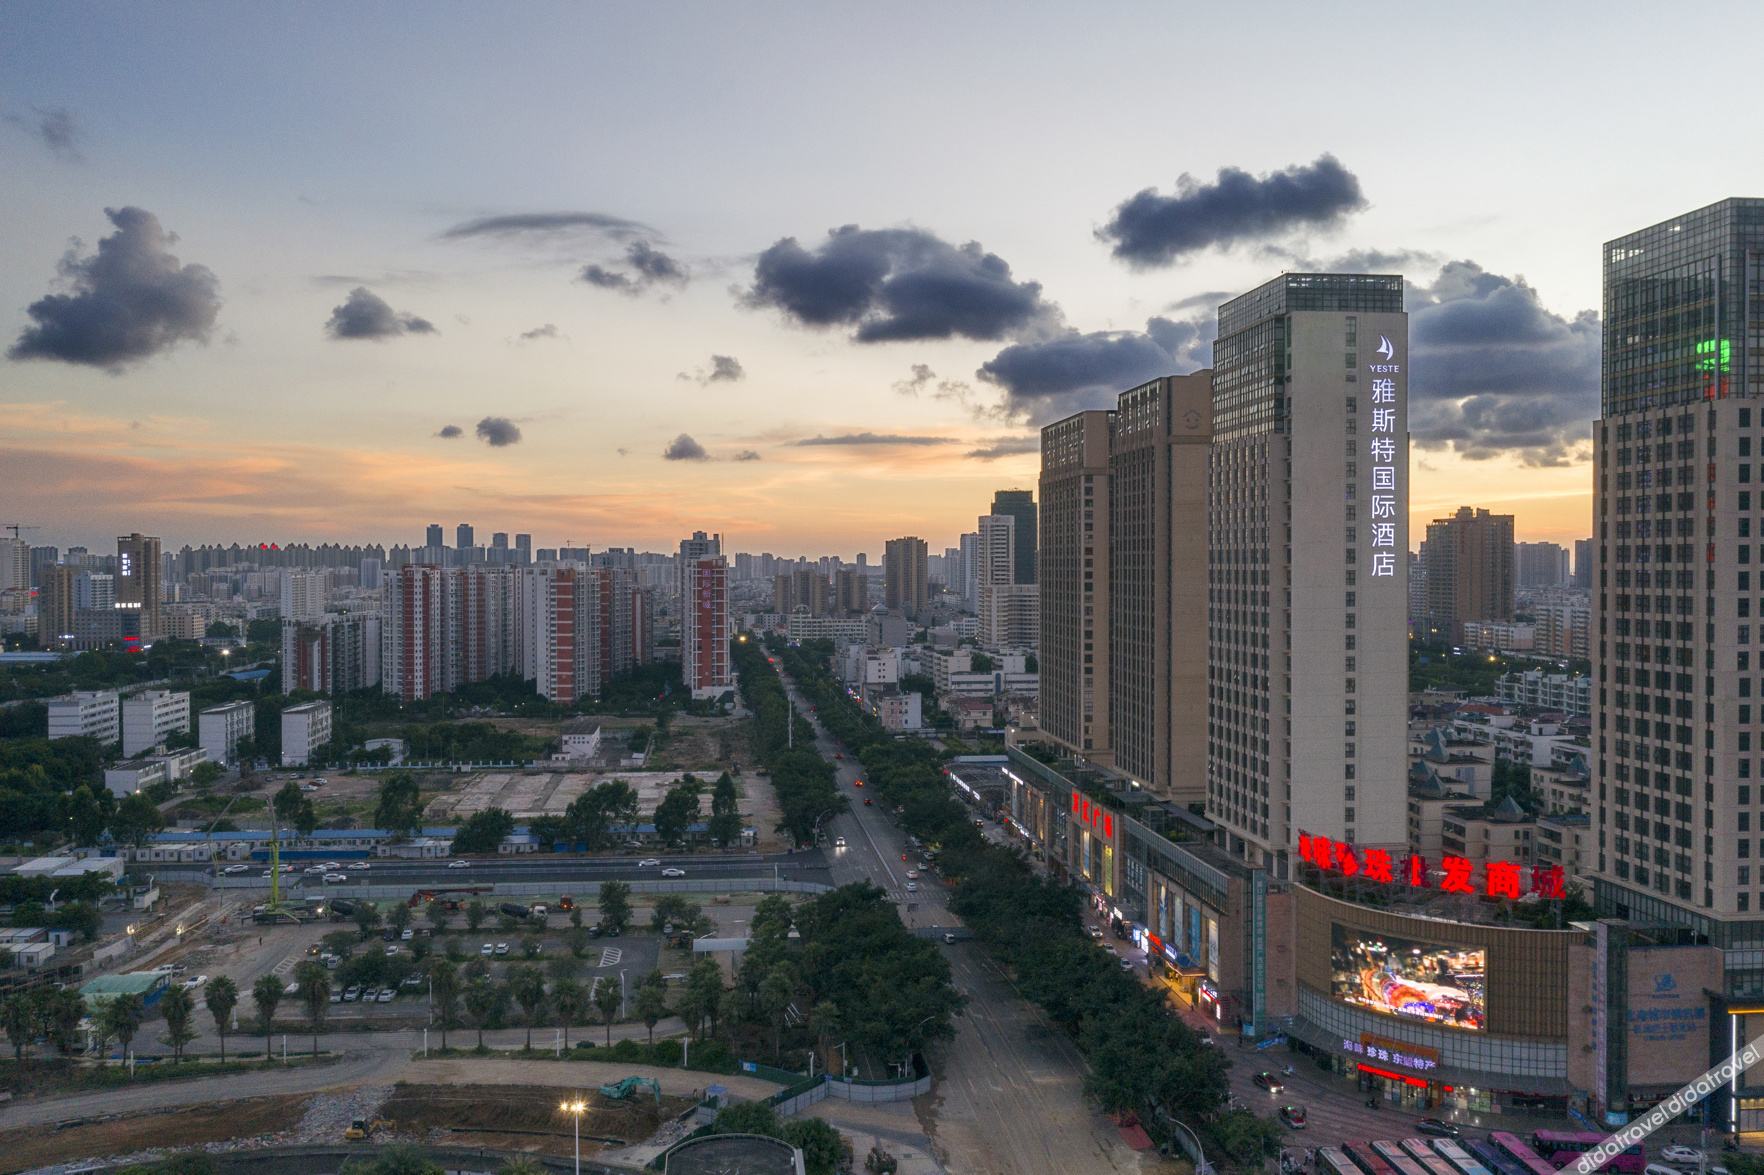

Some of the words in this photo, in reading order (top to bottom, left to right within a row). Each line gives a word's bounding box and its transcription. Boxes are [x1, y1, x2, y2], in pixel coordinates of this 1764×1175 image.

[1369, 364, 1400, 373] YESTE
[1371, 378, 1396, 577] 雅斯特国际酒店
[702, 569, 711, 608] 国际新城
[1366, 1046, 1389, 1061] 珍珠
[1392, 1053, 1436, 1070] 东盟特产
